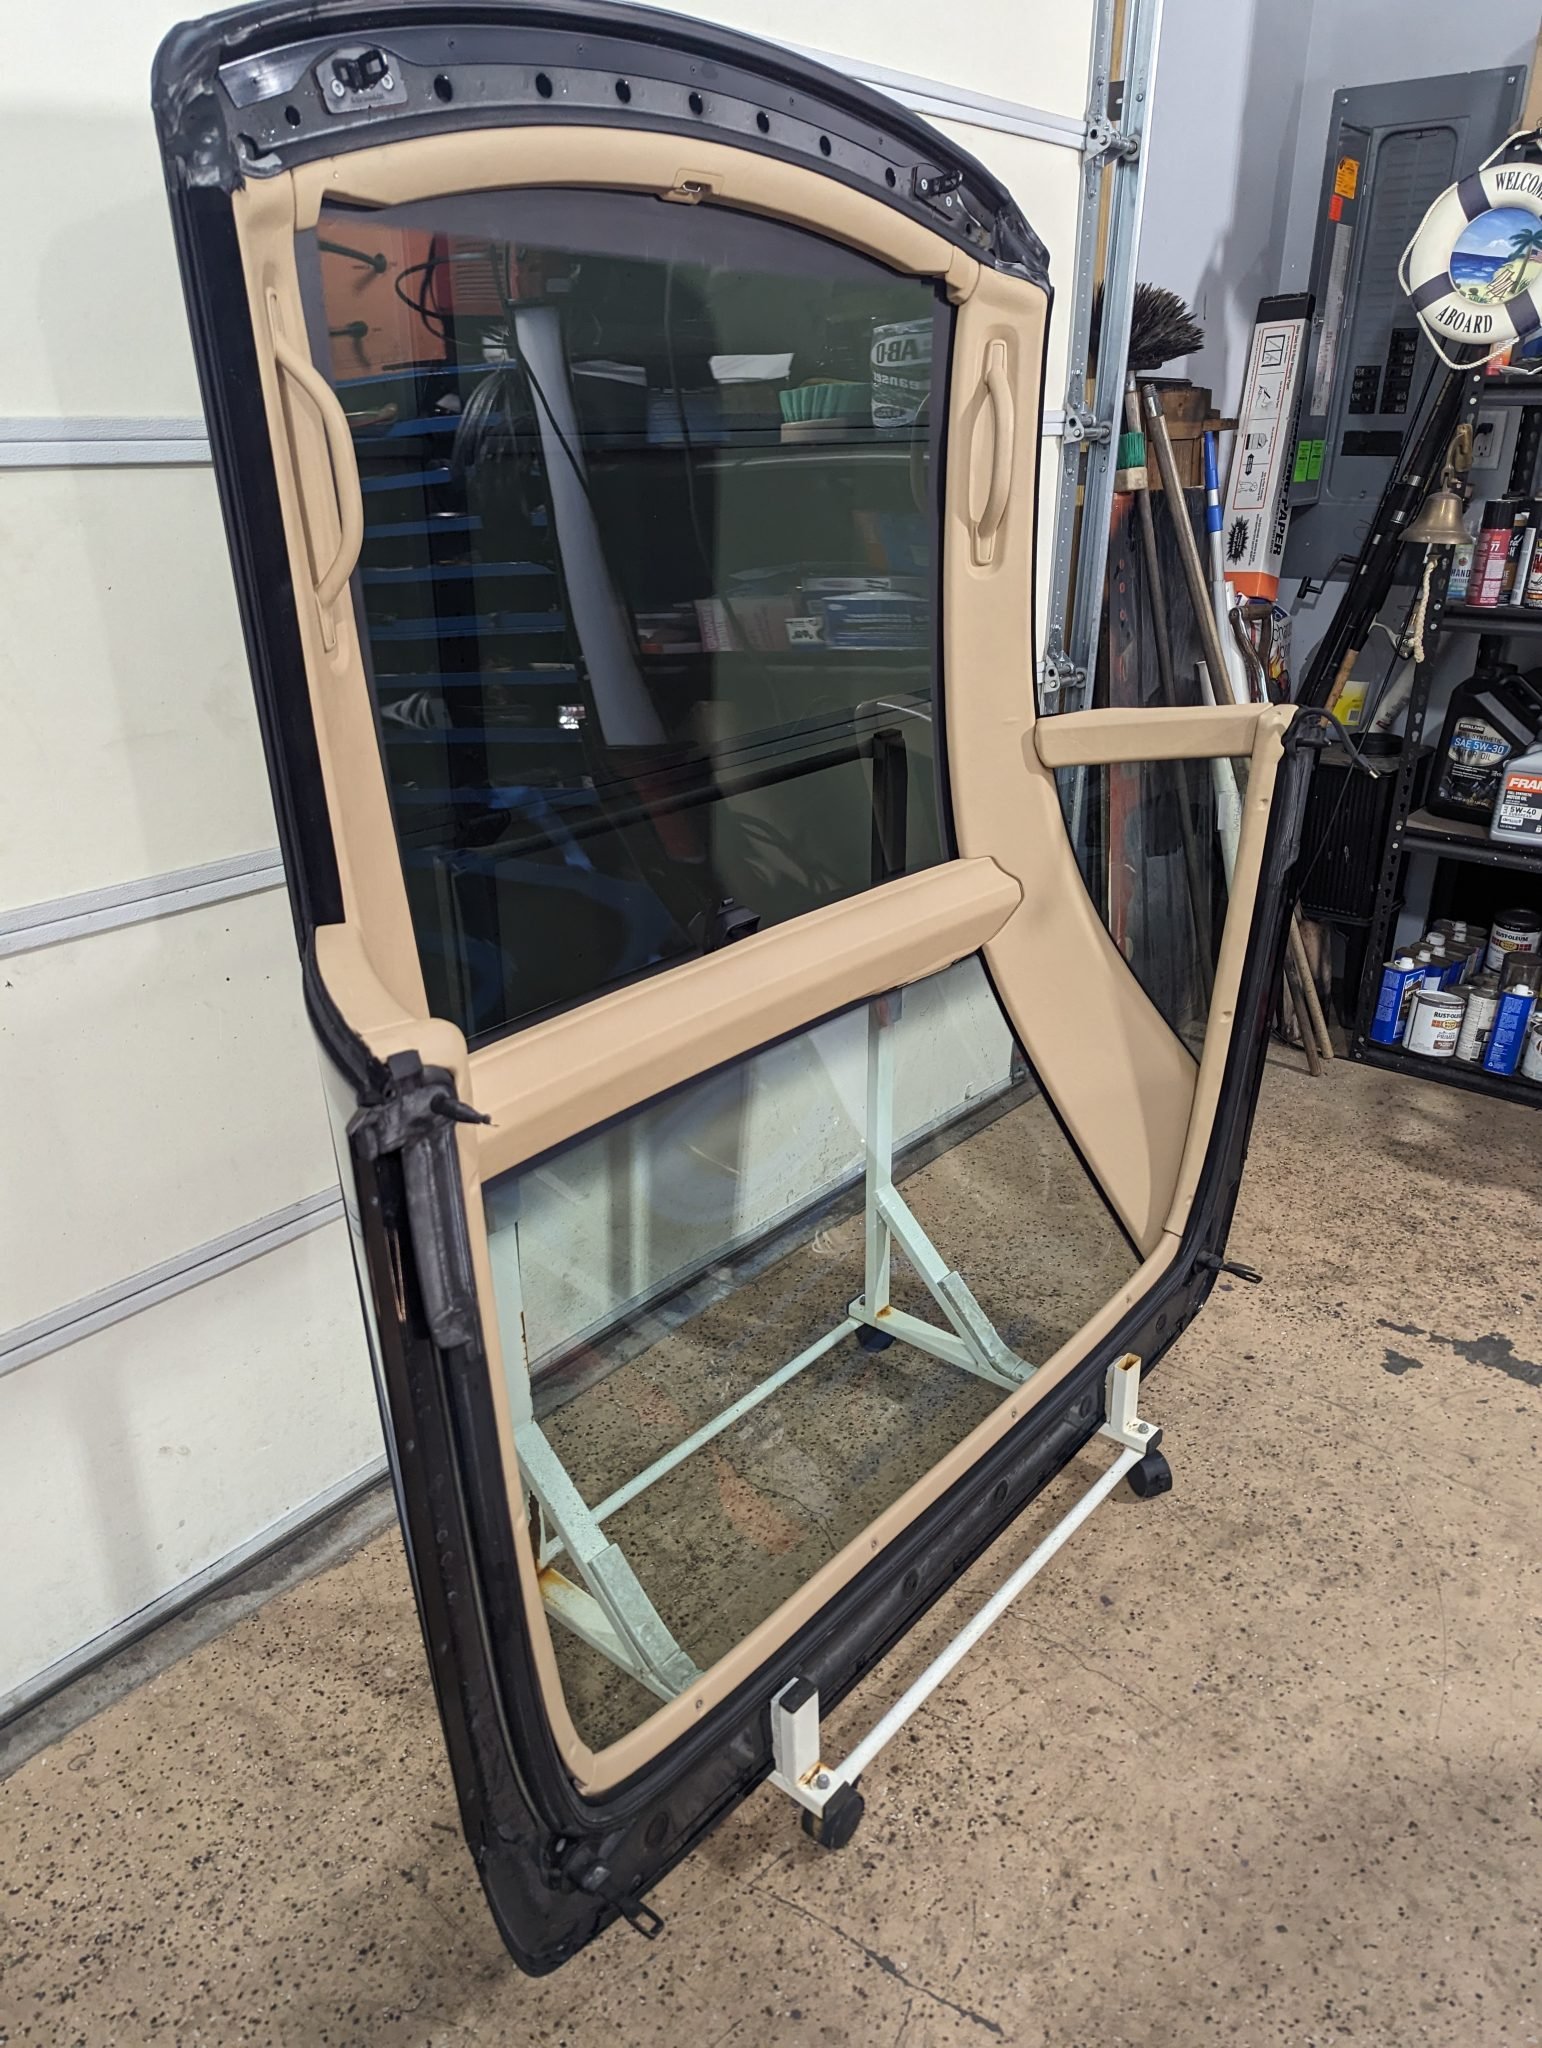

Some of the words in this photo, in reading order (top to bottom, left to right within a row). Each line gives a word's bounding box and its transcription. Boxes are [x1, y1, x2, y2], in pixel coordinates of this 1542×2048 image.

[1435, 305, 1493, 334] ABOARD
[1272, 498, 1290, 555] PAPER
[1490, 543, 1500, 552] 77
[1450, 569, 1471, 577] HAND
[1472, 734, 1503, 744] SYNTHETIC
[1454, 738, 1471, 748] SAE
[1473, 741, 1505, 754] 5W-30
[1480, 752, 1491, 761] OIL
[1510, 806, 1537, 816] 5W-40
[1495, 931, 1529, 942] RUST-OLEUM
